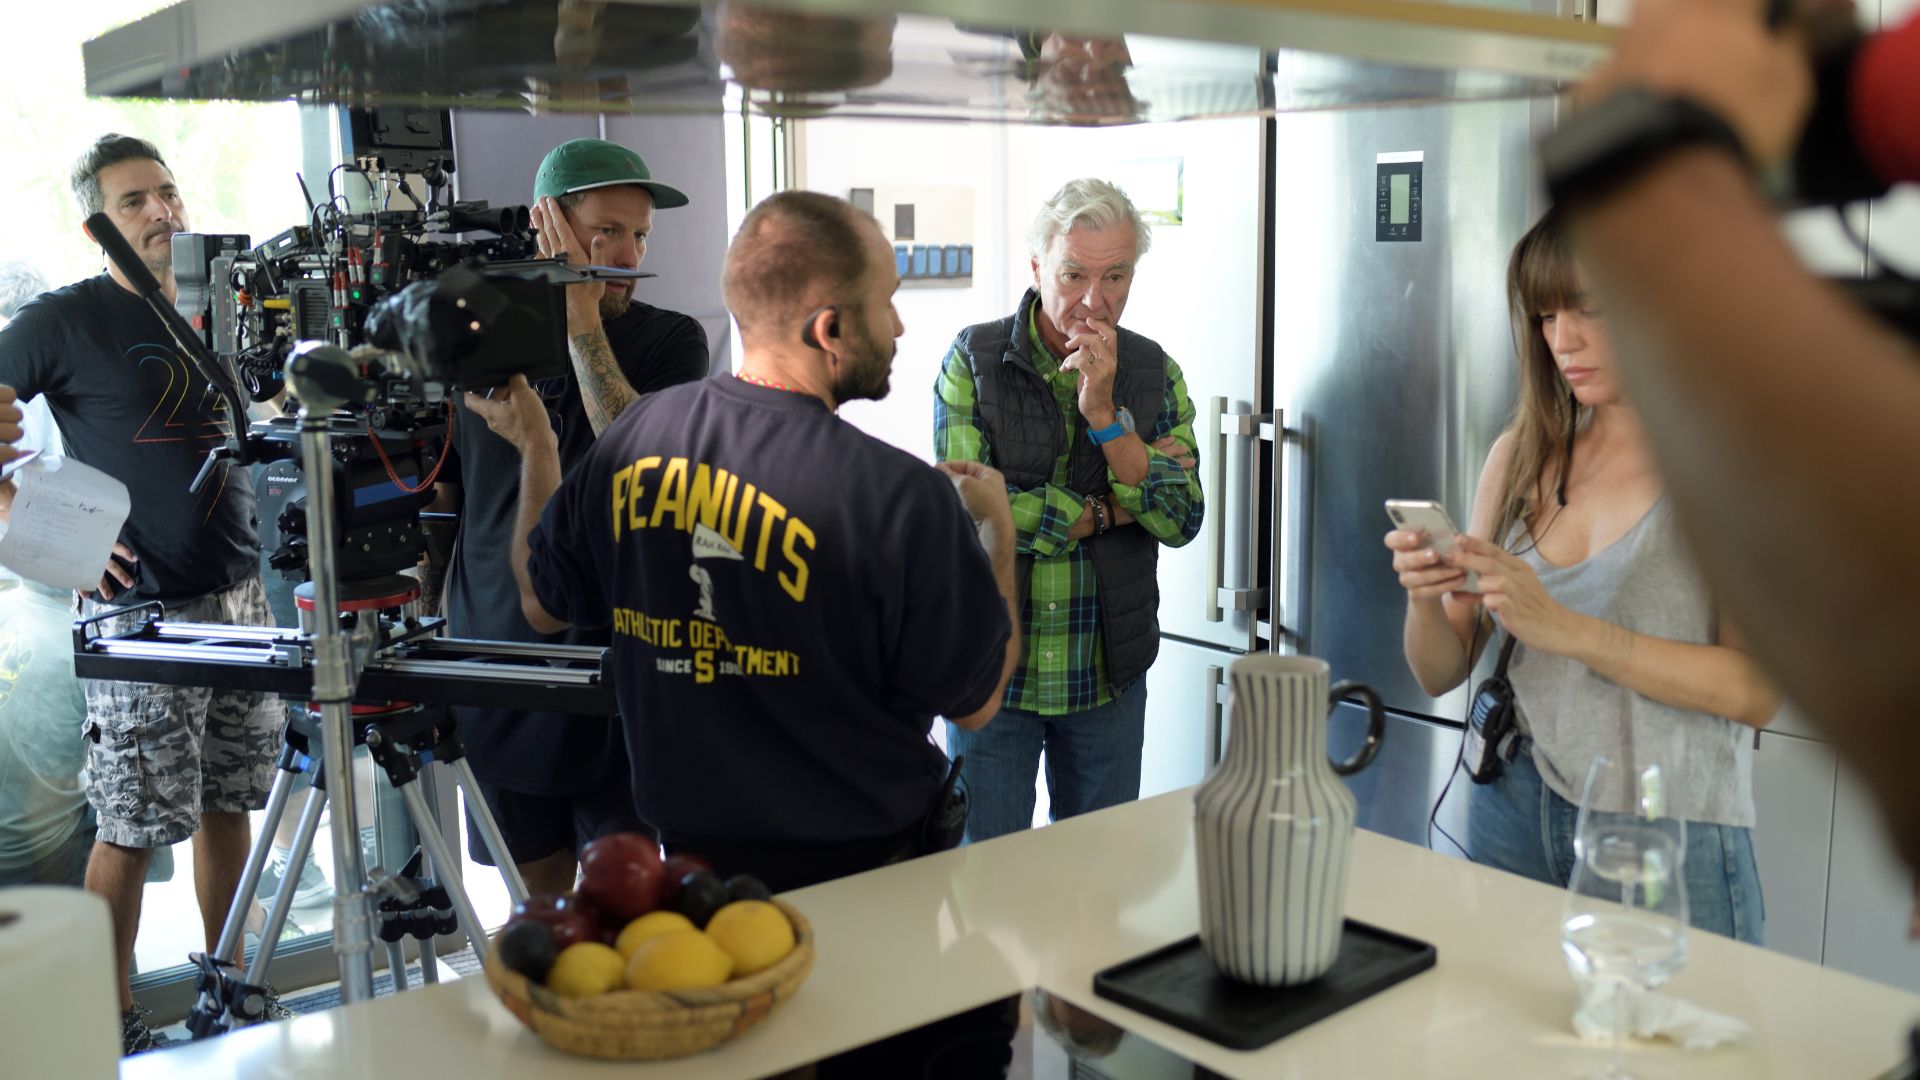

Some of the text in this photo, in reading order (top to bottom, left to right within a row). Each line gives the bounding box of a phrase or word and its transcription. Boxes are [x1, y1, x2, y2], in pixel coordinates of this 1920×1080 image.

[611, 456, 816, 603] PEANUTS
[656, 658, 692, 674] SINCE
[694, 650, 715, 684] S
[689, 620, 801, 677] DEPTMENT
